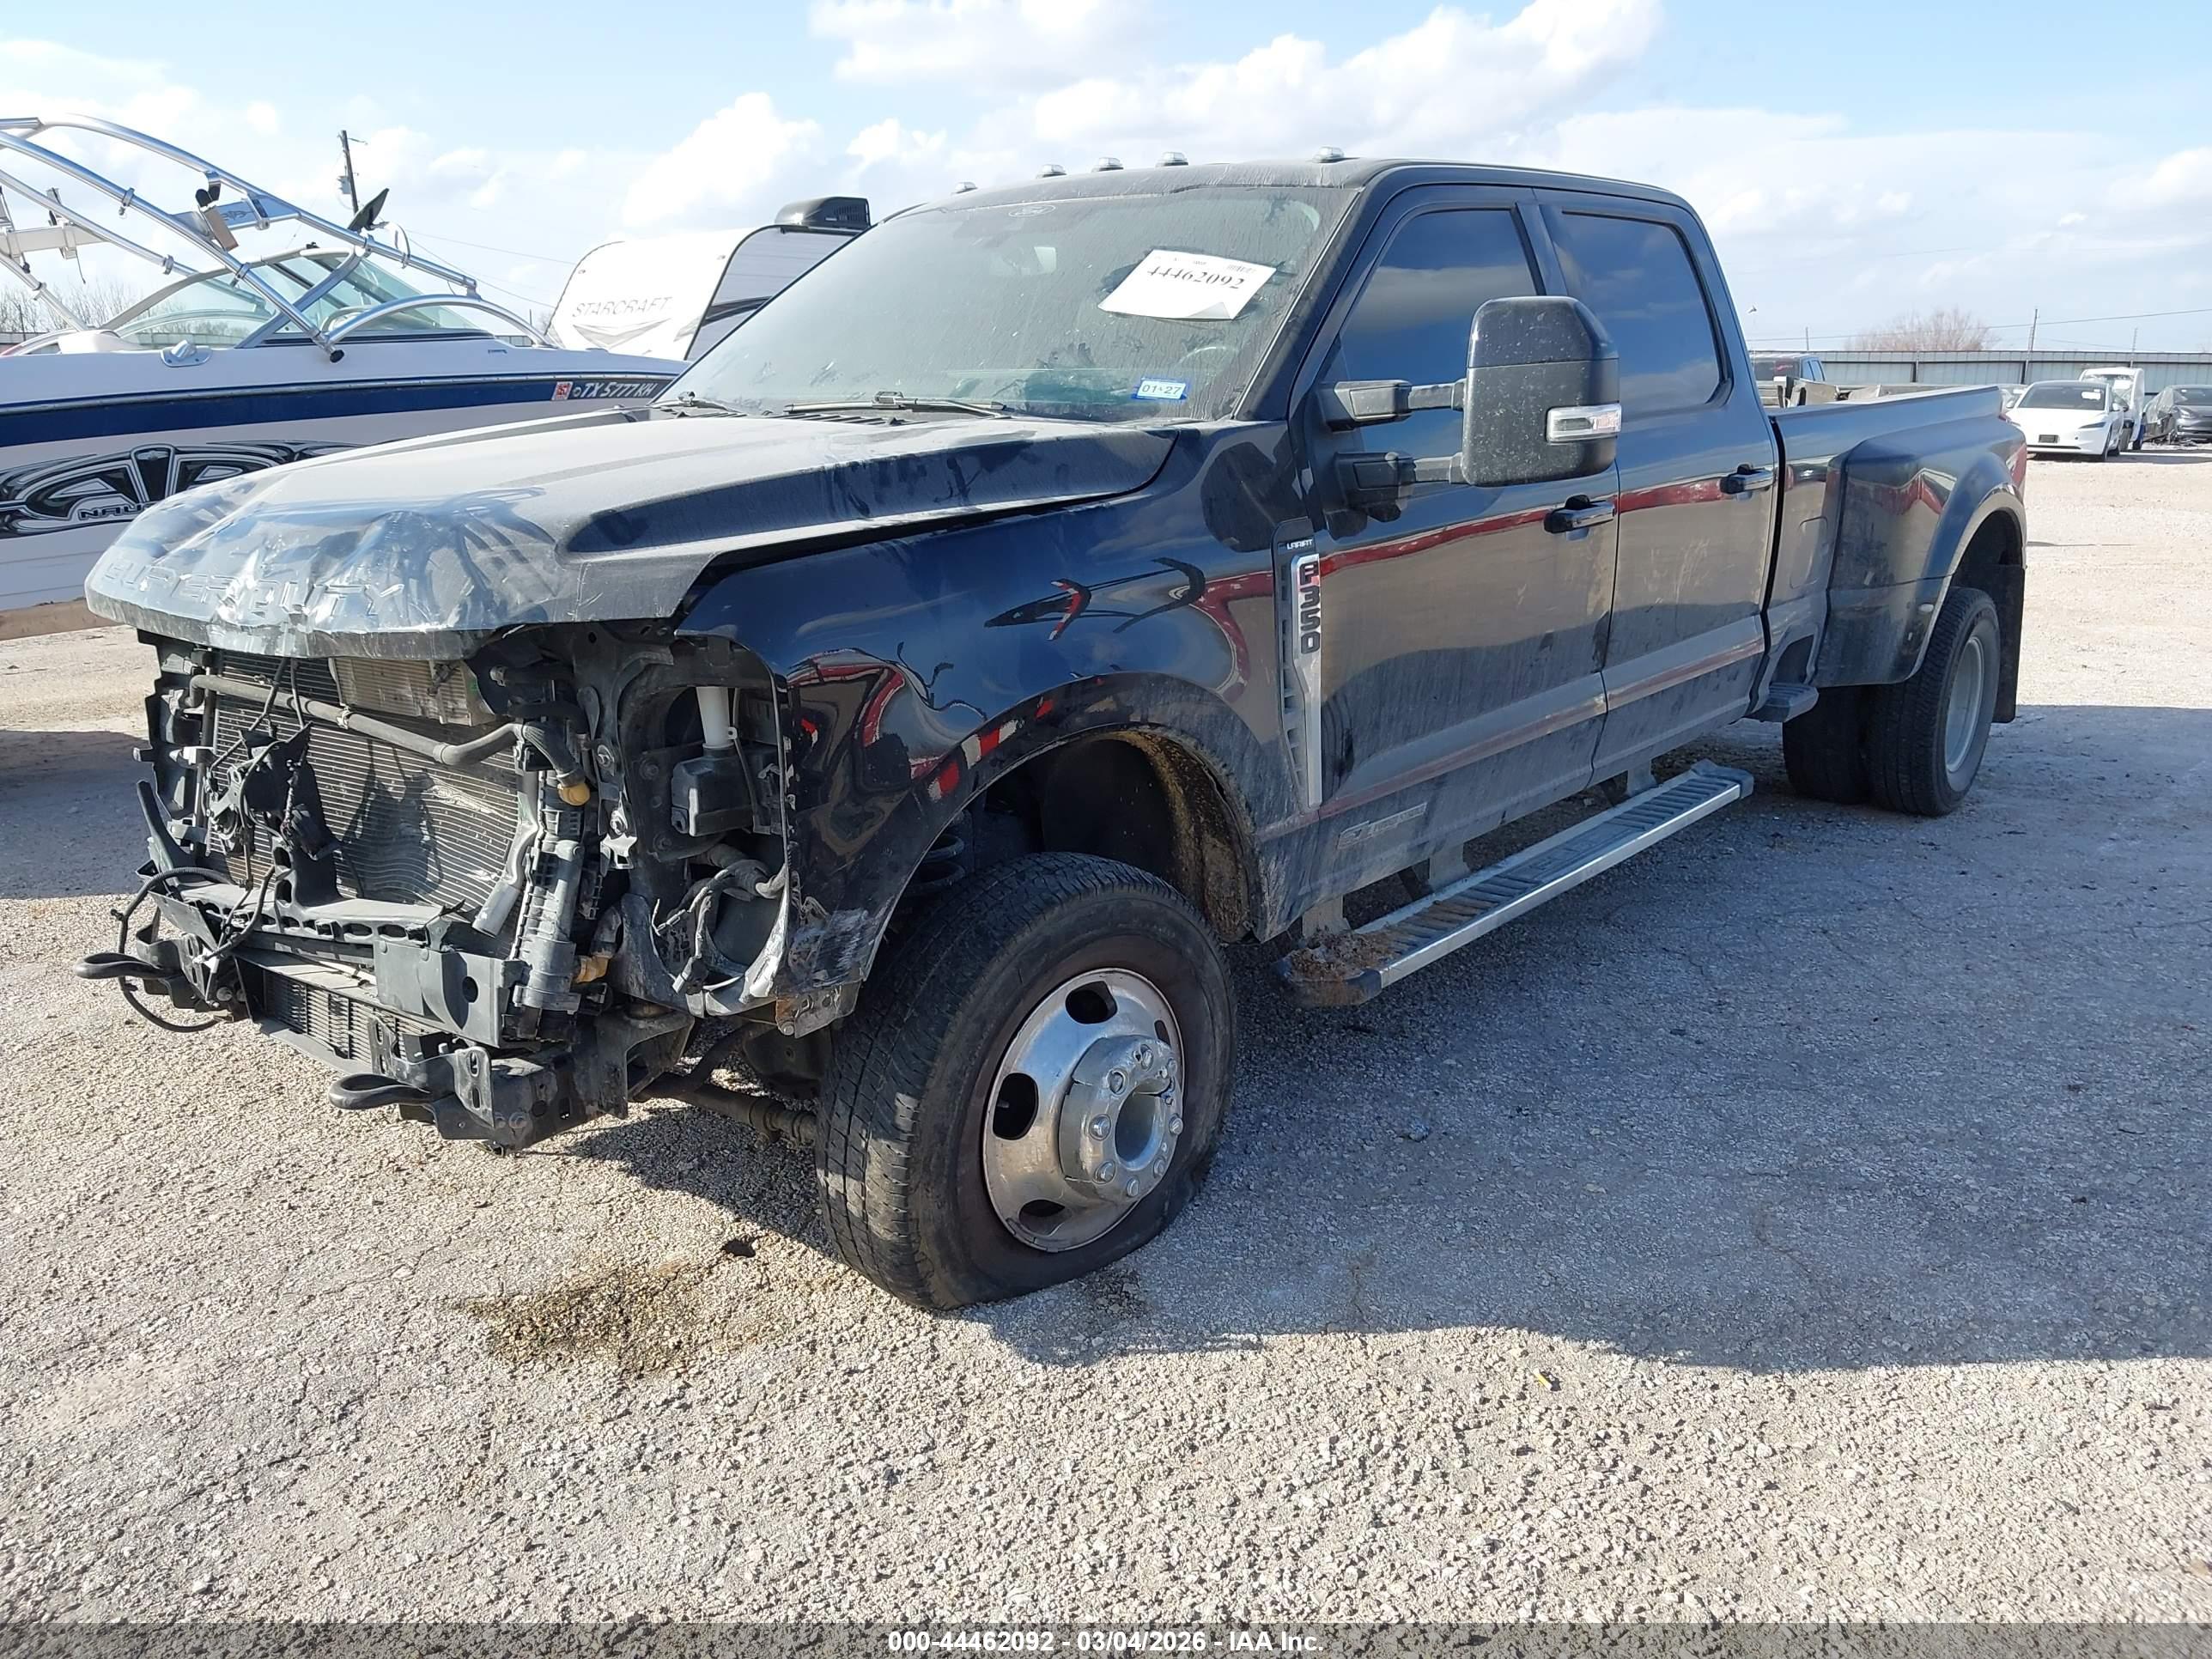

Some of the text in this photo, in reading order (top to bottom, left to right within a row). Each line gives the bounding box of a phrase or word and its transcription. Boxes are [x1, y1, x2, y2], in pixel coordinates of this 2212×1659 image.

[1147, 265, 1245, 289] 44462092
[572, 296, 673, 318] STARCRAFT
[580, 382, 604, 398] TX
[1286, 538, 1313, 550] LARIAT
[103, 561, 405, 617] SUPER DUTY
